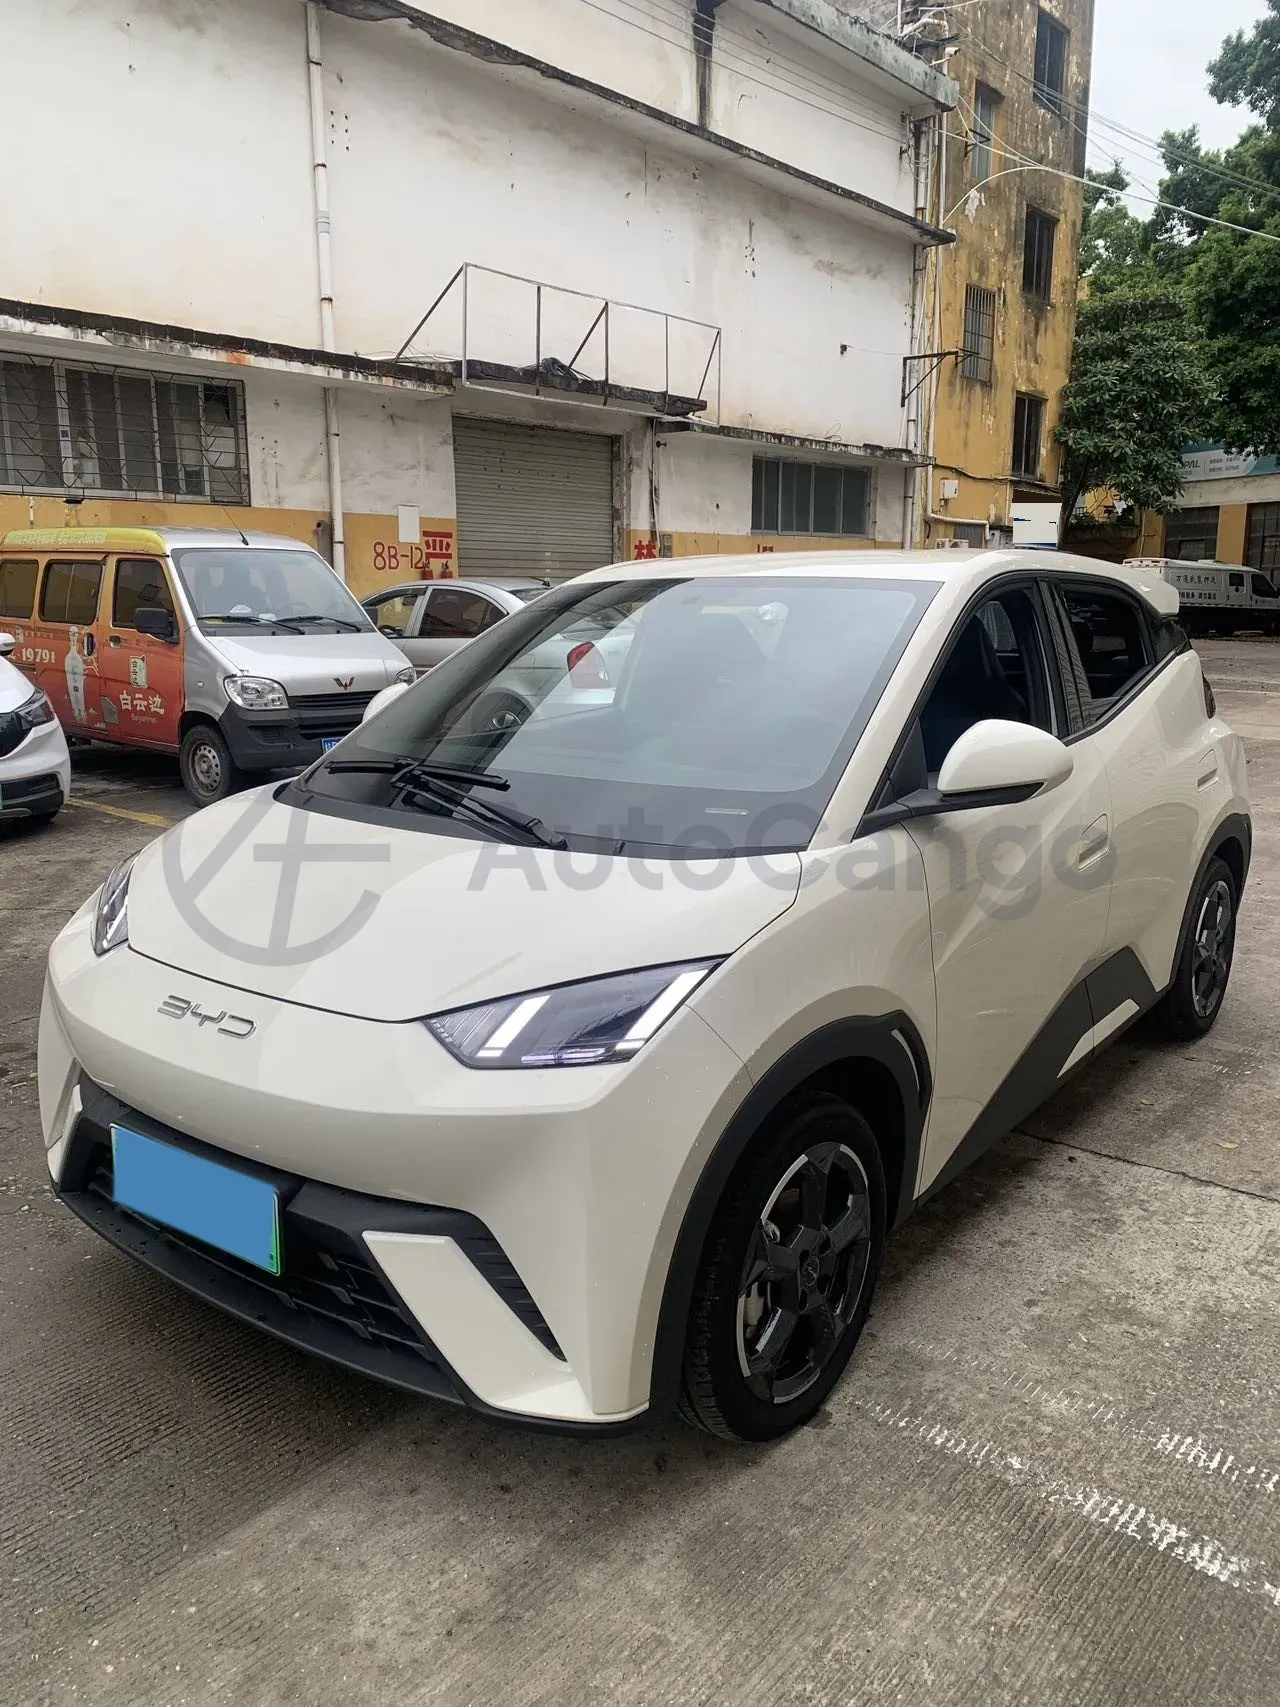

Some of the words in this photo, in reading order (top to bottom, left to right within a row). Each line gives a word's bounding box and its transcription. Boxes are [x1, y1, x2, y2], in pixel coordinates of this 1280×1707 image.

[373, 541, 425, 571] 8B-12
[119, 690, 164, 715] 白云边
[157, 995, 257, 1039] BYD
